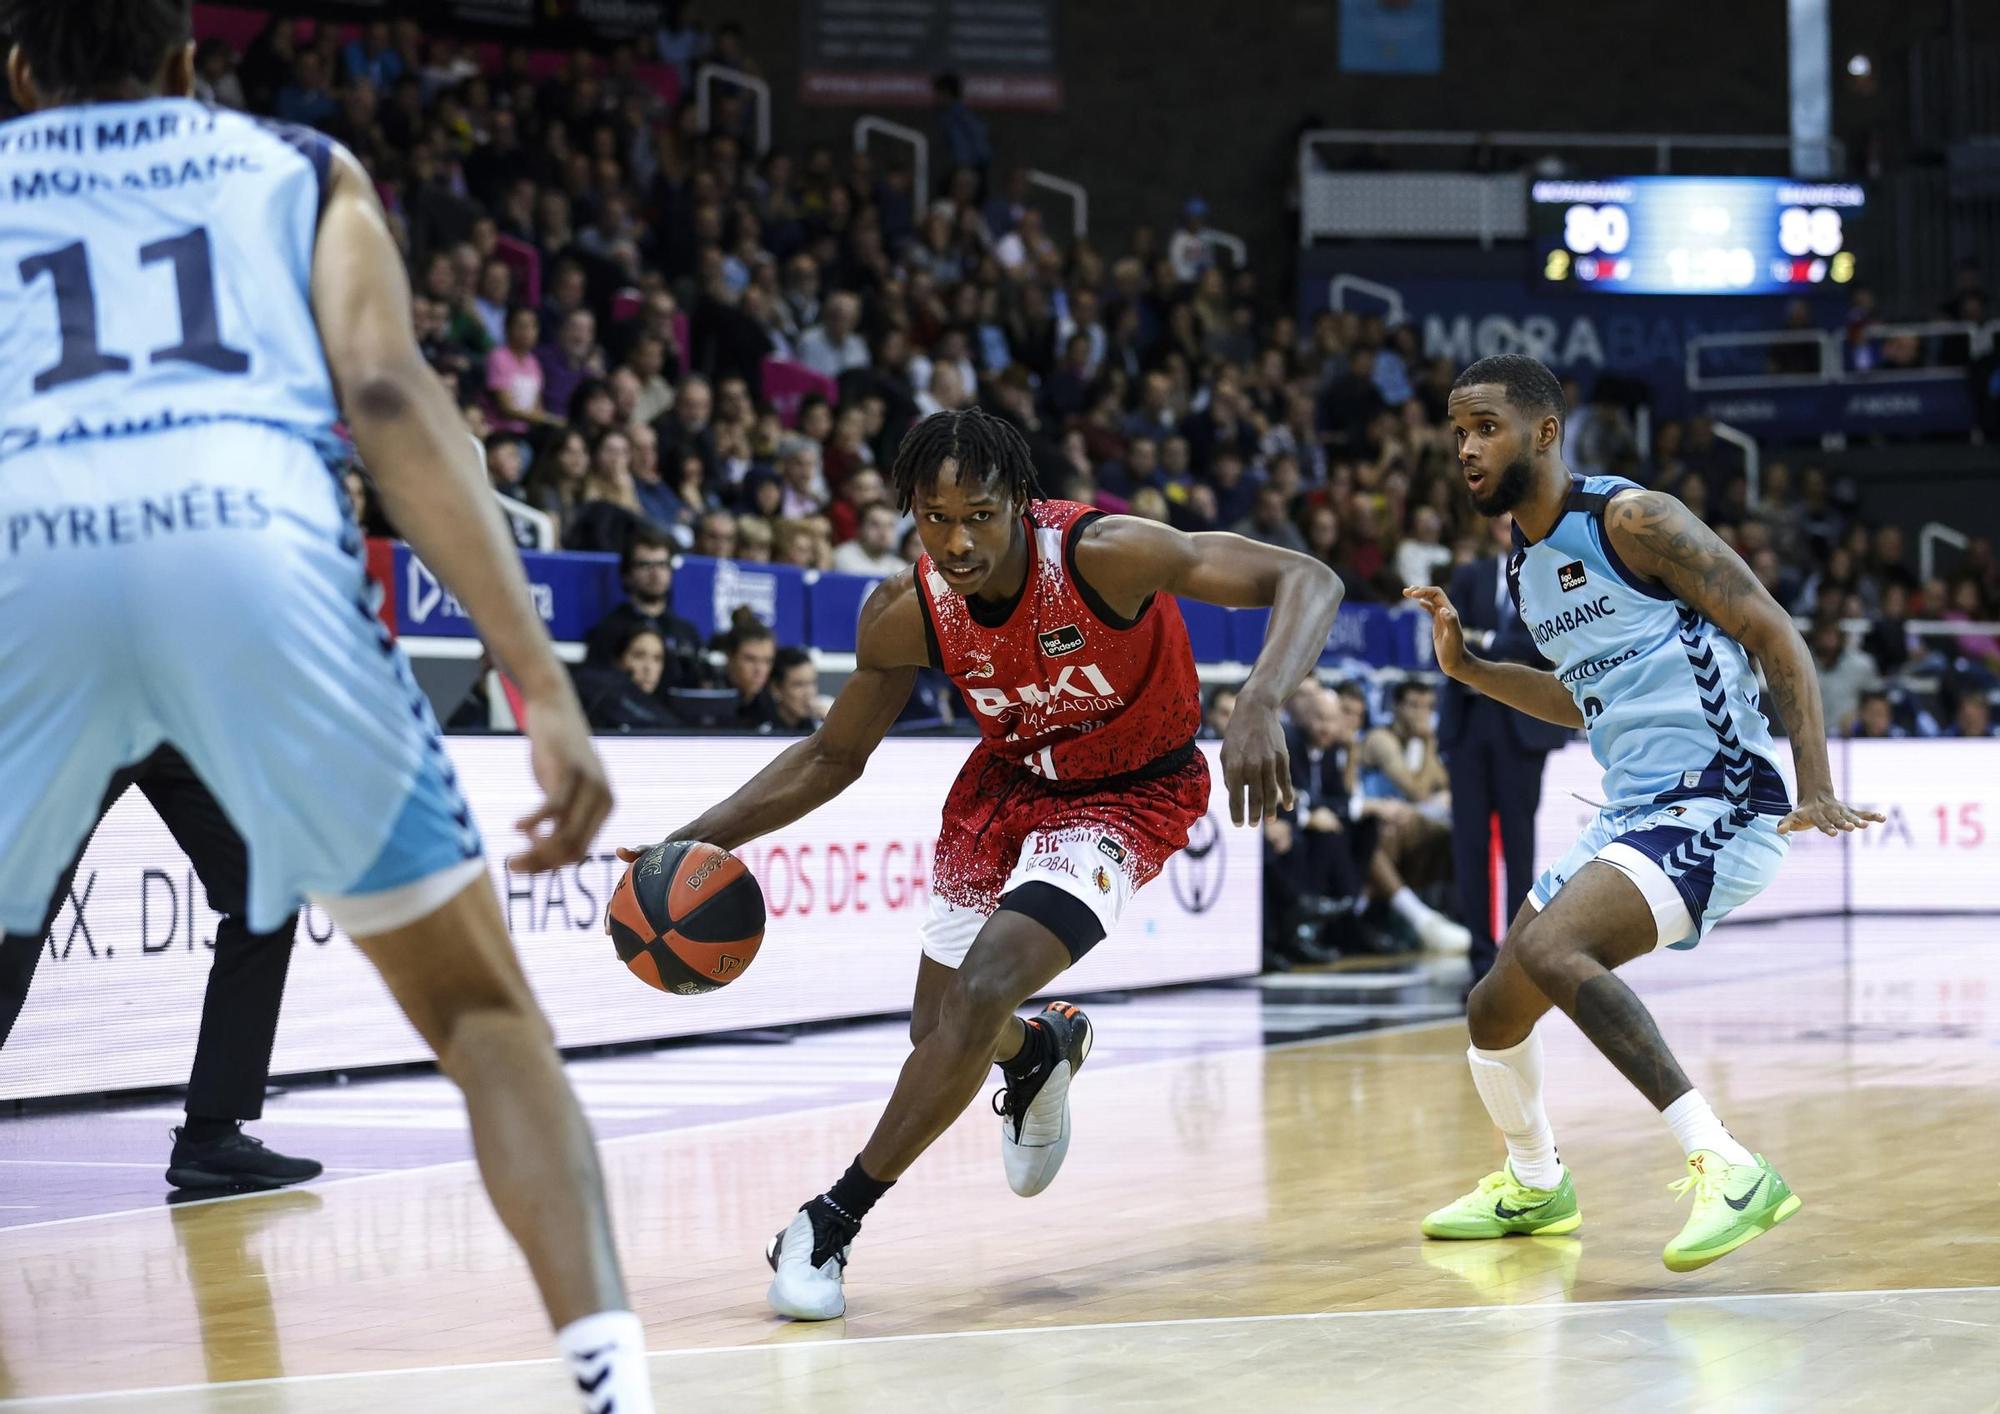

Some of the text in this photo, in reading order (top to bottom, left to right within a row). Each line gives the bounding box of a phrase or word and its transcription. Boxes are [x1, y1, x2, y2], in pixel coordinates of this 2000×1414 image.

[1565, 204, 1629, 254] 80
[18, 226, 251, 392] 11
[9, 484, 271, 554] PYRENÉES
[1561, 573, 1572, 584] liga
[1563, 575, 1586, 590] endesa
[1044, 638, 1061, 649] liga
[1048, 638, 1082, 654] endesa
[1936, 802, 1986, 848] 15
[1099, 843, 1119, 860] acb
[827, 842, 871, 913] DE
[1026, 856, 1079, 879] GLOBAL
